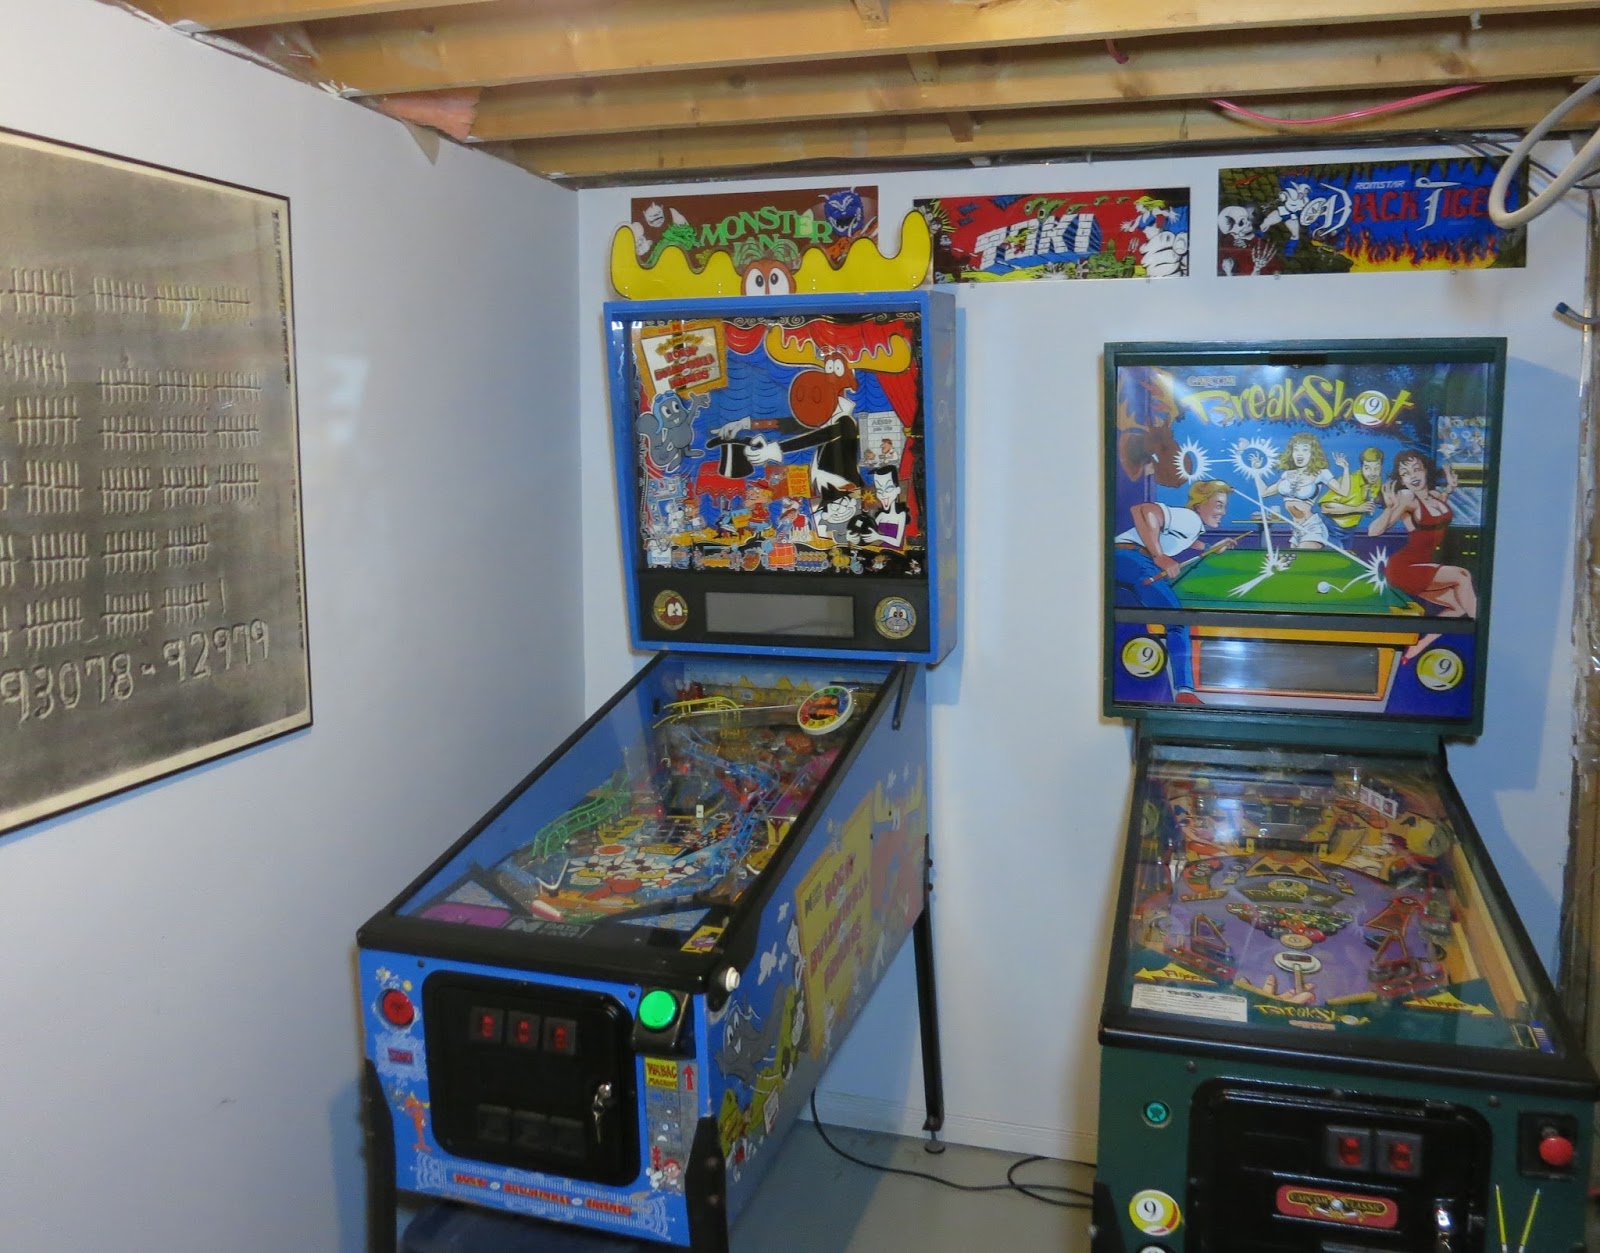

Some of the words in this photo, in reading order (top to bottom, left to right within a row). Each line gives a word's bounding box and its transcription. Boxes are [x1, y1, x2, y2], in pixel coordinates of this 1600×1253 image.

[1355, 179, 1406, 190] ROMSTAR
[1415, 176, 1510, 232] TIGE
[700, 206, 833, 248] MONSTER
[1142, 646, 1154, 663] 9
[1439, 658, 1452, 674] 9
[1144, 1200, 1156, 1219] 9
